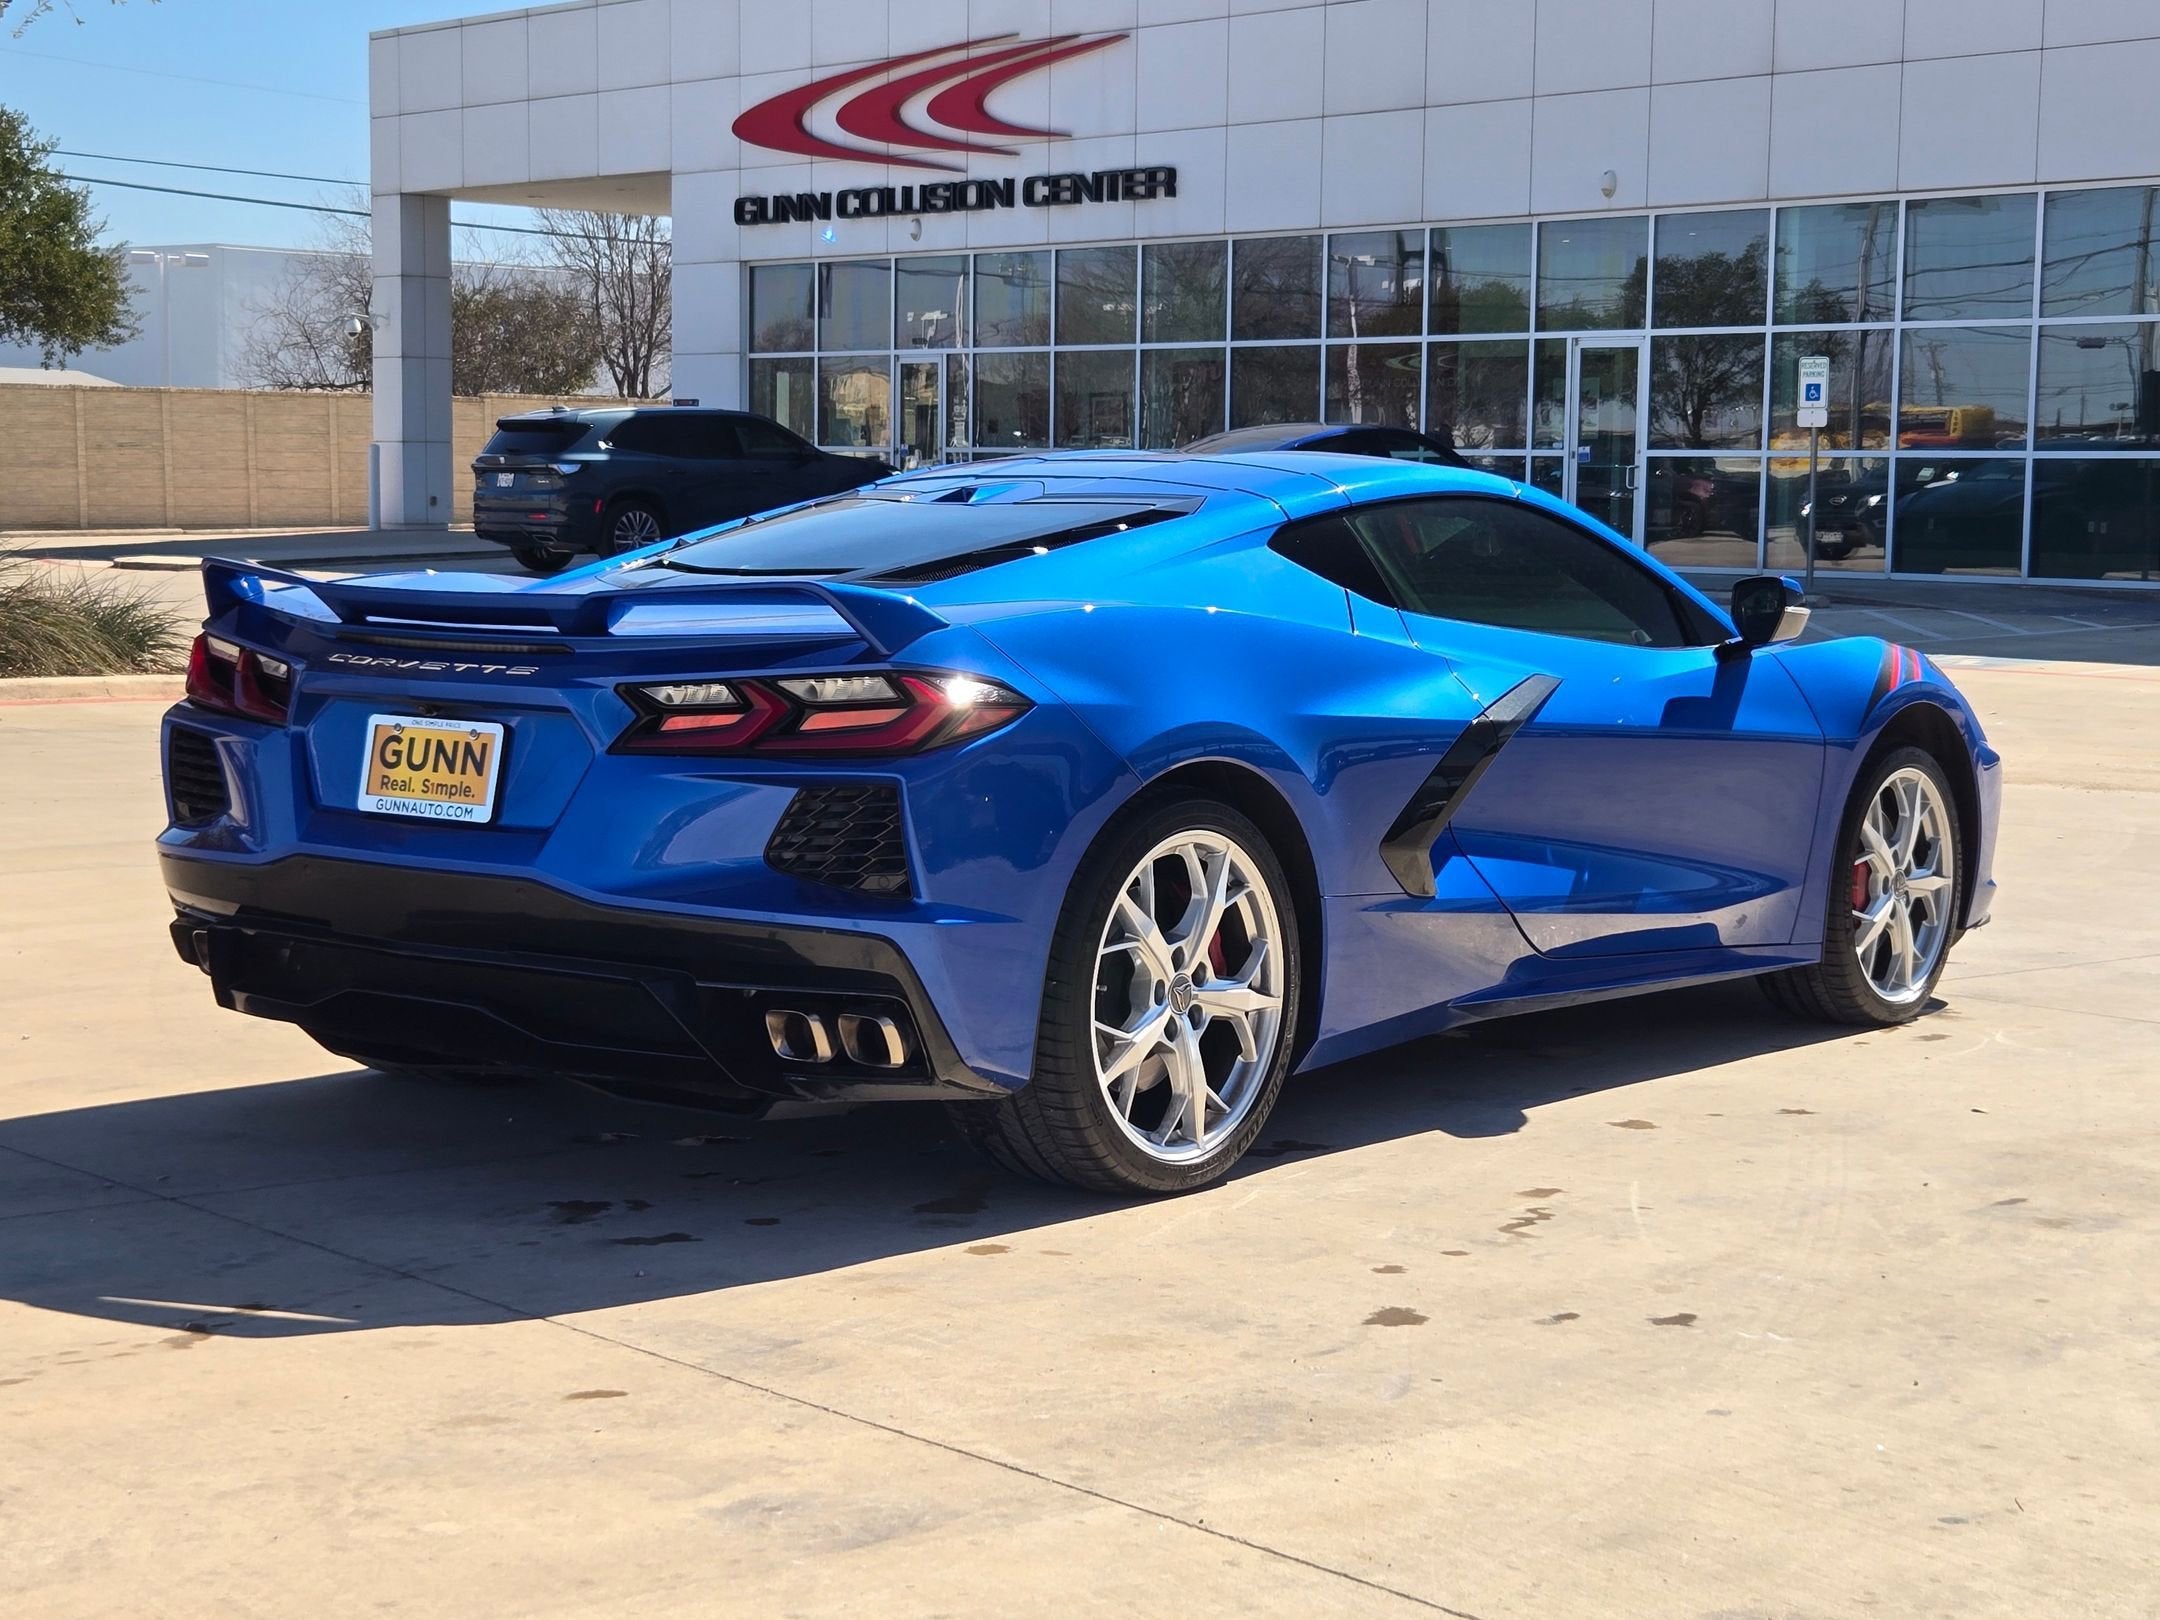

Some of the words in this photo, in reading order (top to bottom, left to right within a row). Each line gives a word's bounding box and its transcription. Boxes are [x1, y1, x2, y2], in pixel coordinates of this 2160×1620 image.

[734, 192, 832, 226] GUNN
[836, 178, 1015, 219] COLLISION
[1023, 166, 1177, 207] CENTER
[328, 653, 540, 675] CORVETTE
[379, 734, 488, 777] GUNN
[380, 774, 415, 793] Real.
[376, 798, 474, 819] GUNNAUTO.COM
